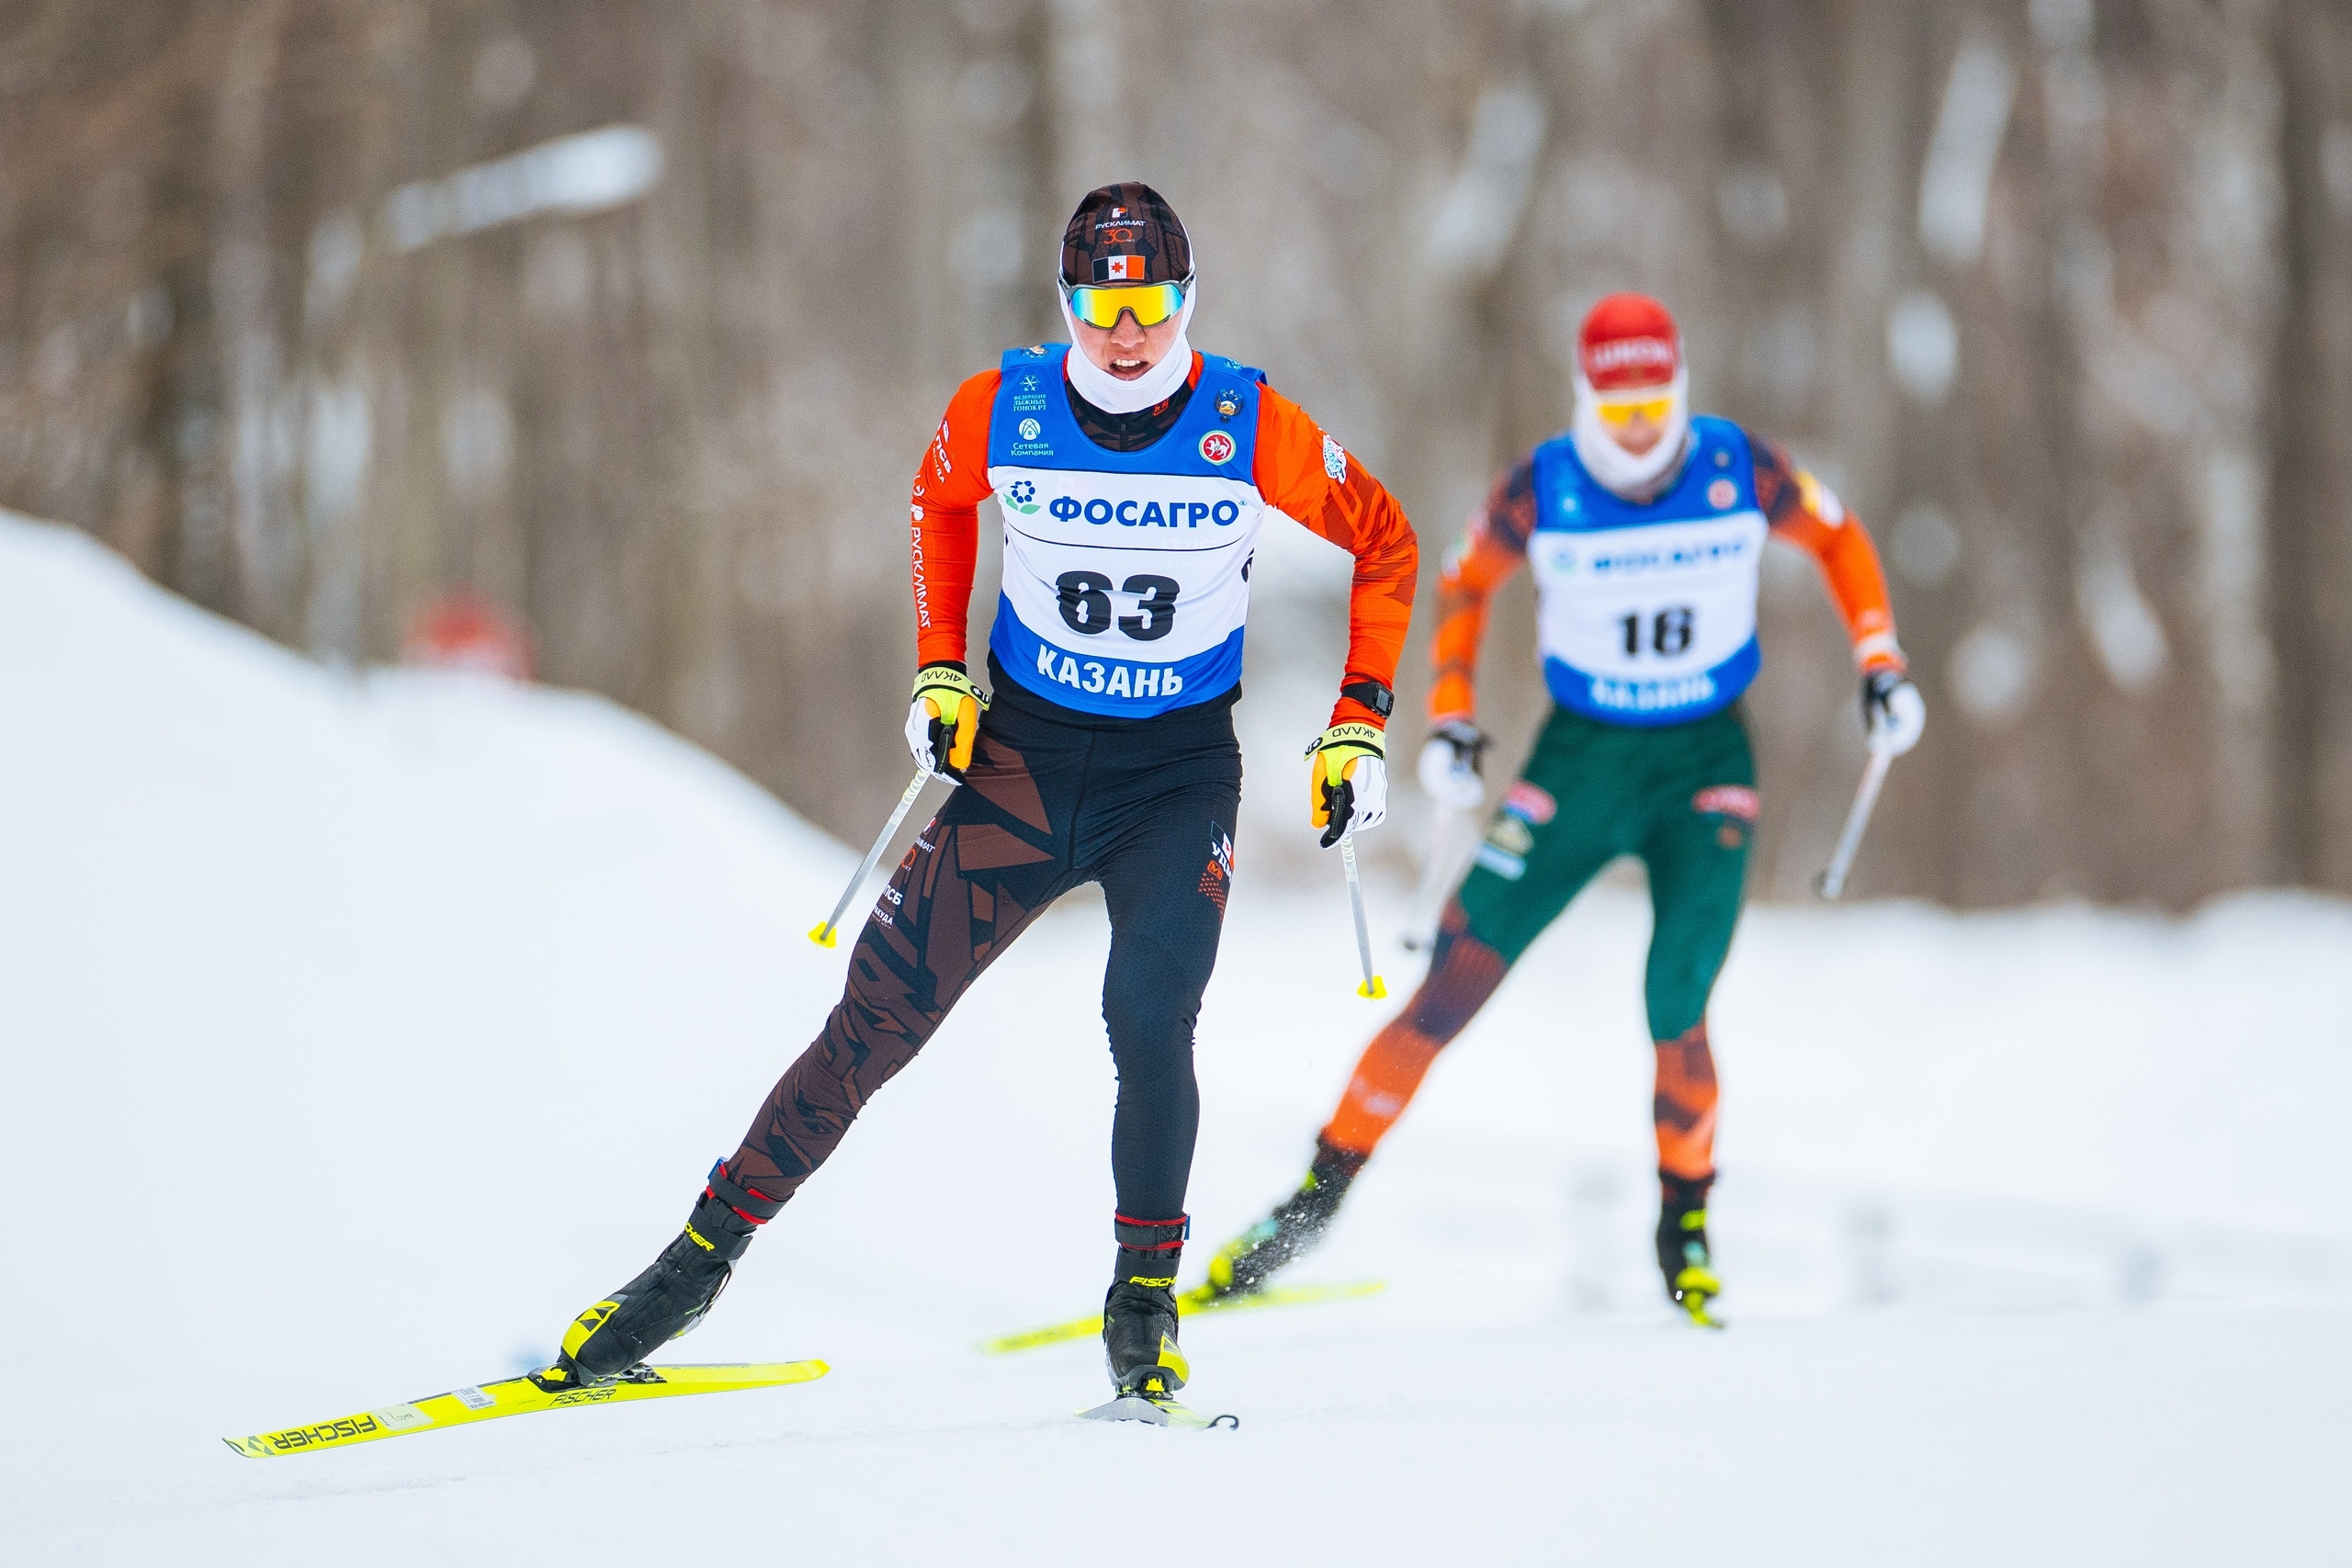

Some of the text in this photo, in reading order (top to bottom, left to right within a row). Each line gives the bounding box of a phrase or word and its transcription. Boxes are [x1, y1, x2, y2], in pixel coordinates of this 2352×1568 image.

[1095, 220, 1146, 230] РУСКЛИМАТ
[1012, 442, 1049, 450] Сетевая
[1049, 495, 1239, 528] ФОСАГРО
[1056, 570, 1181, 641] 63
[1036, 643, 1183, 698] КАЗАНЬ
[549, 1389, 616, 1406] FISCHER
[268, 1415, 378, 1450] FISCHER
